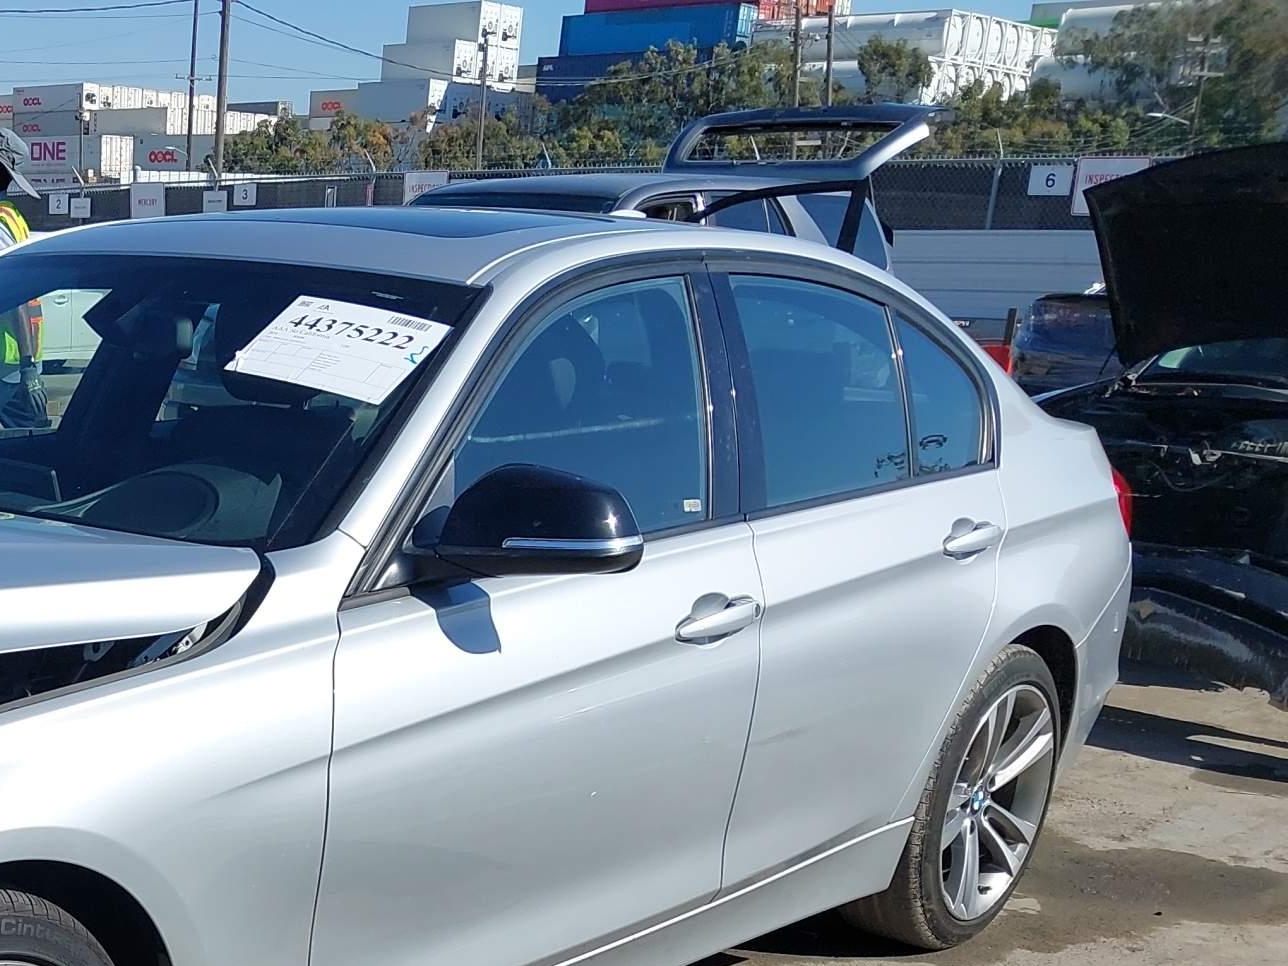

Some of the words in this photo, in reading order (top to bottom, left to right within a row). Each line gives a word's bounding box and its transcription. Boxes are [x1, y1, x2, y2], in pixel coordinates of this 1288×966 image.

[31, 142, 66, 160] ONE
[1046, 173, 1056, 188] 6
[242, 189, 248, 200] 3
[56, 199, 62, 209] 2
[289, 315, 414, 350] 44375222
